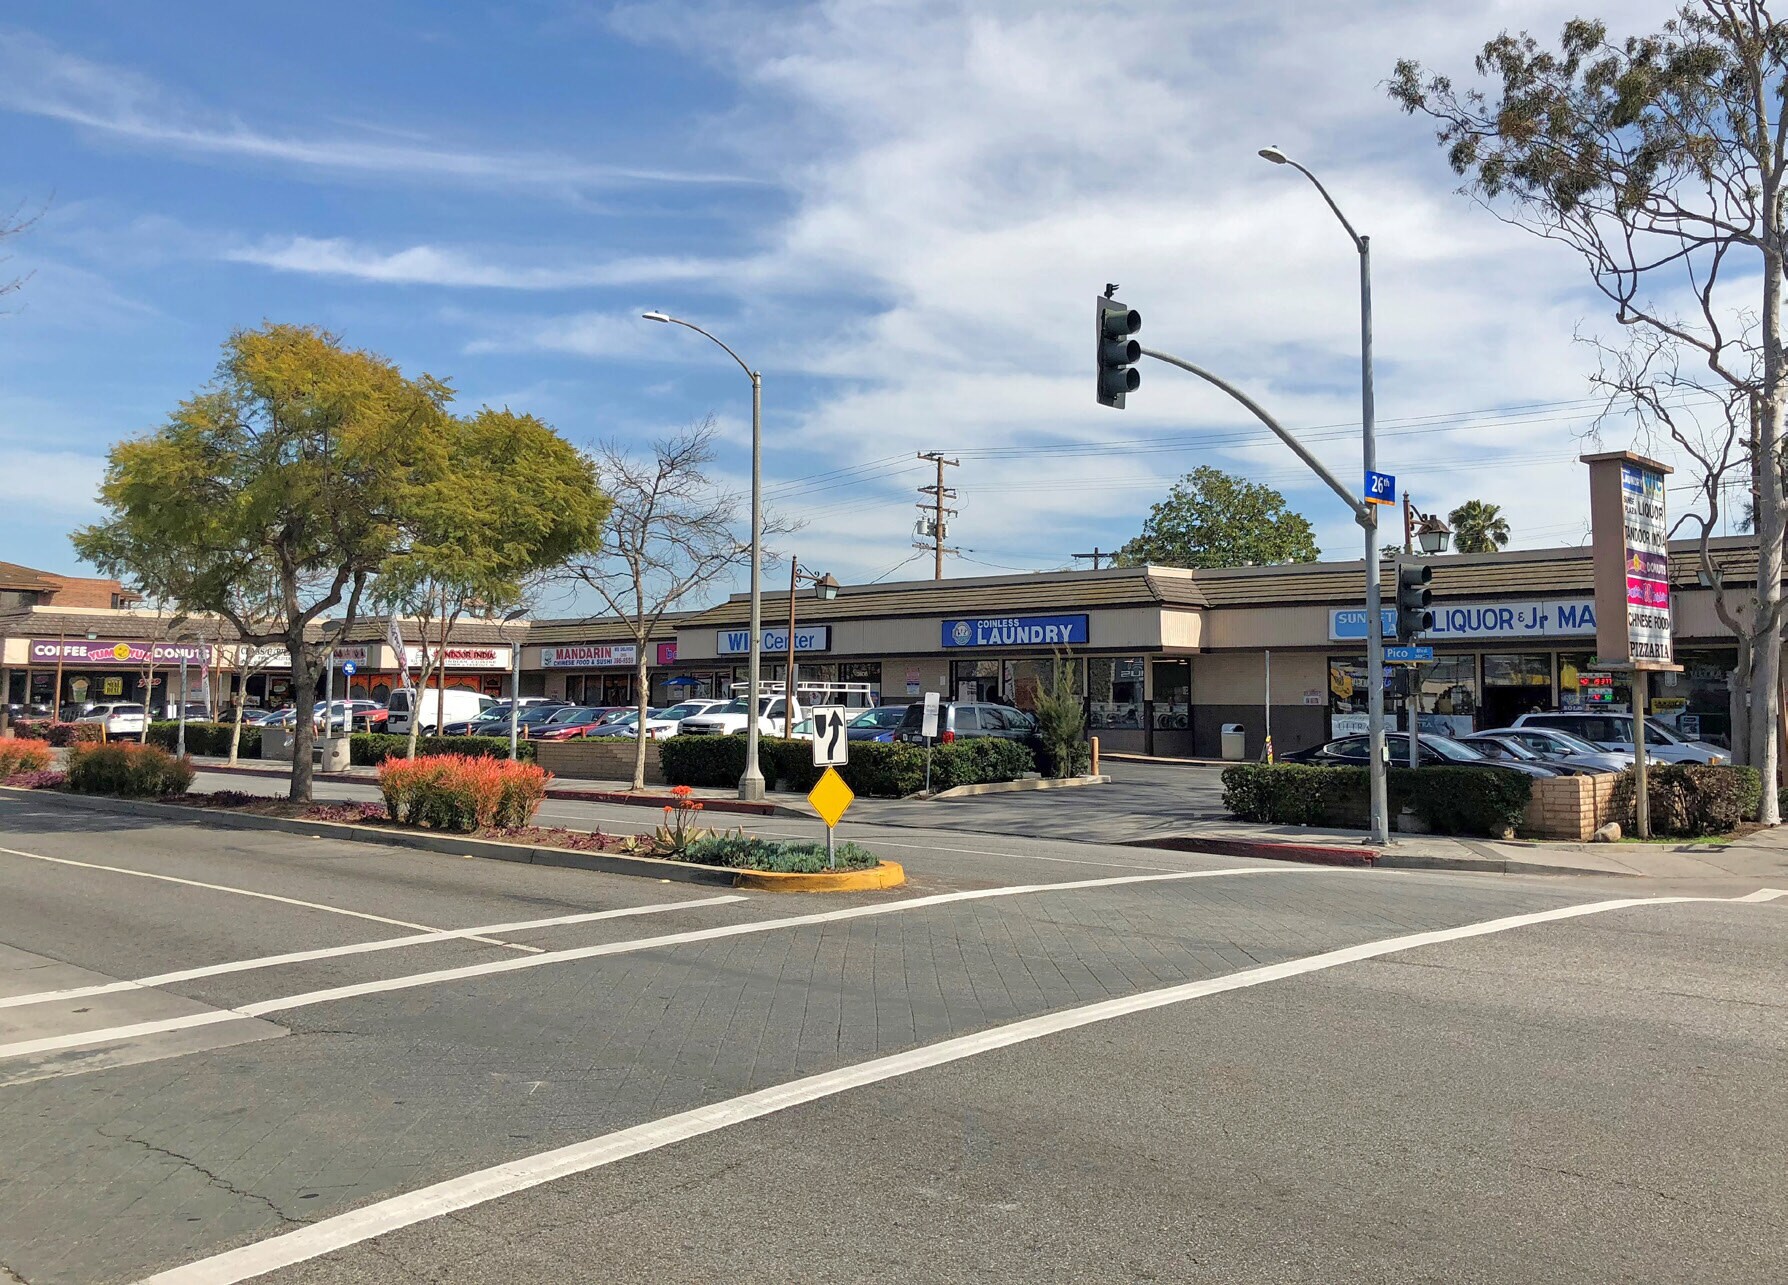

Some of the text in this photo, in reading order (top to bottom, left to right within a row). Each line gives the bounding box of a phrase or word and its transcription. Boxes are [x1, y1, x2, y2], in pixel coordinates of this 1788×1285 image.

[1371, 475, 1390, 494] 26th
[1637, 500, 1664, 521] LIQUOR
[1646, 561, 1667, 576] DONUTS
[977, 618, 1019, 628] COINLESS
[1431, 608, 1515, 633] LIQUOR
[1628, 612, 1670, 630] CHINESE FOOD
[977, 624, 1073, 645] LAUNDRY
[556, 647, 612, 660] MANDARIN
[1387, 648, 1408, 658] Pico
[1629, 641, 1670, 658] PIZZARIA
